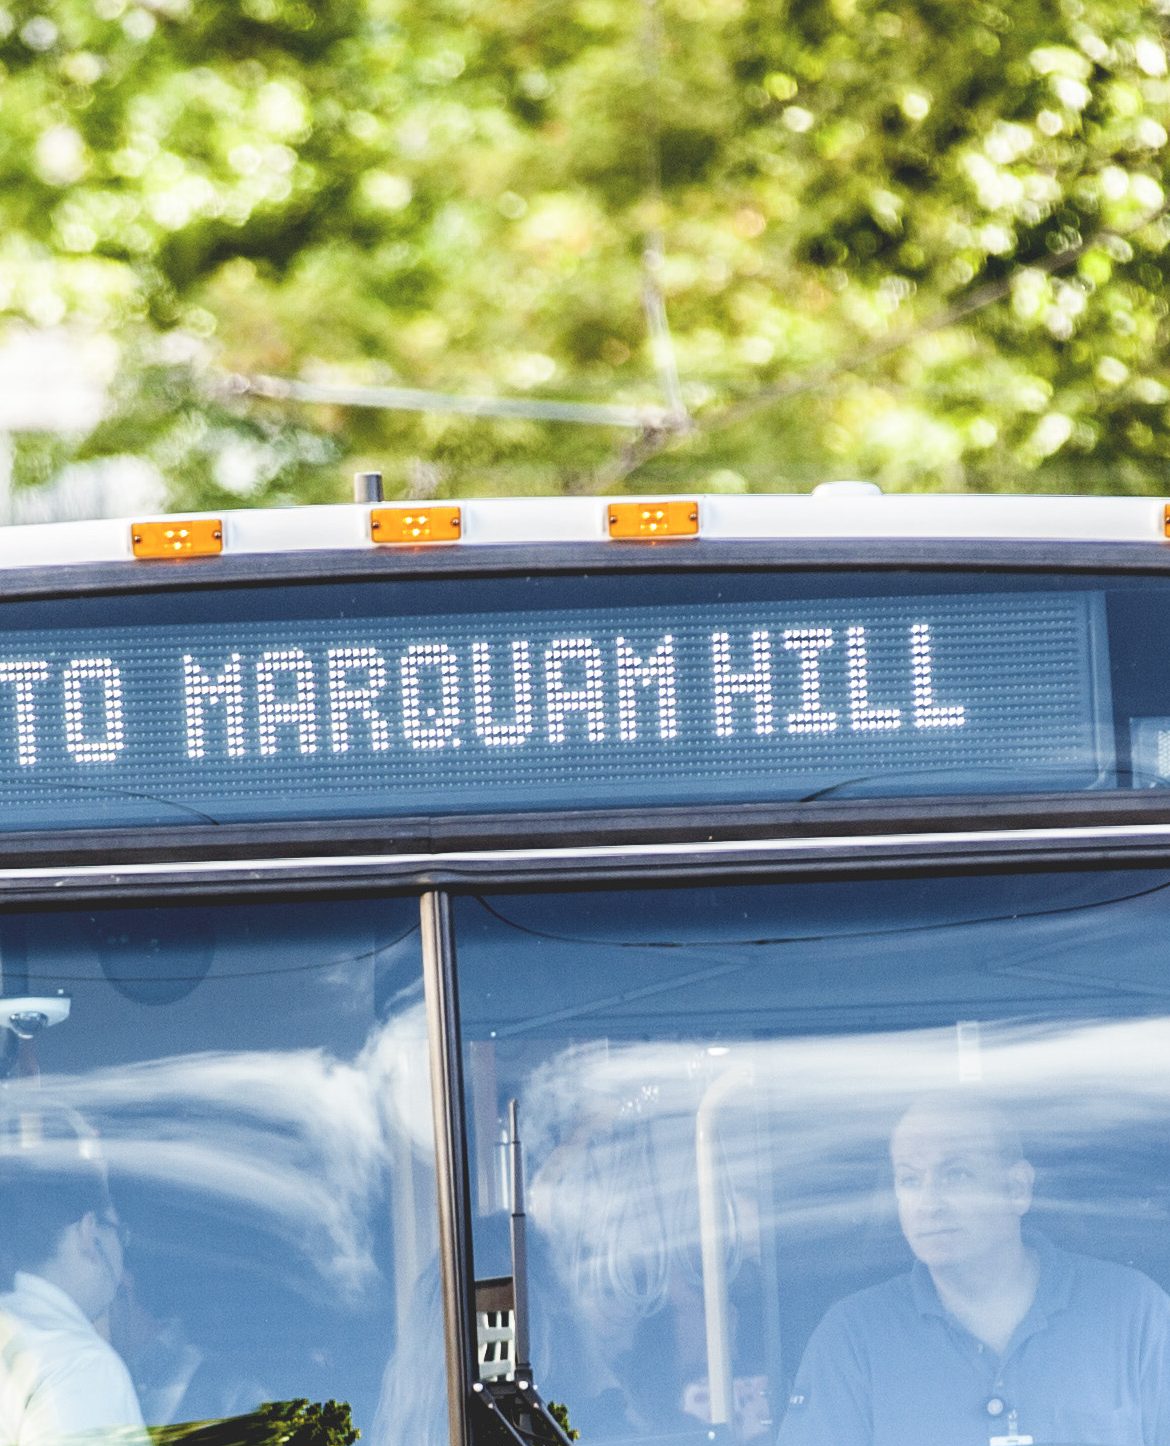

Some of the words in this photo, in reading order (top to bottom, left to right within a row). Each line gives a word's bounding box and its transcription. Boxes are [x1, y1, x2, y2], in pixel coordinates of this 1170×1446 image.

[0, 657, 124, 765] TO
[182, 633, 677, 758] MARQUAM
[711, 623, 966, 737] HILL
